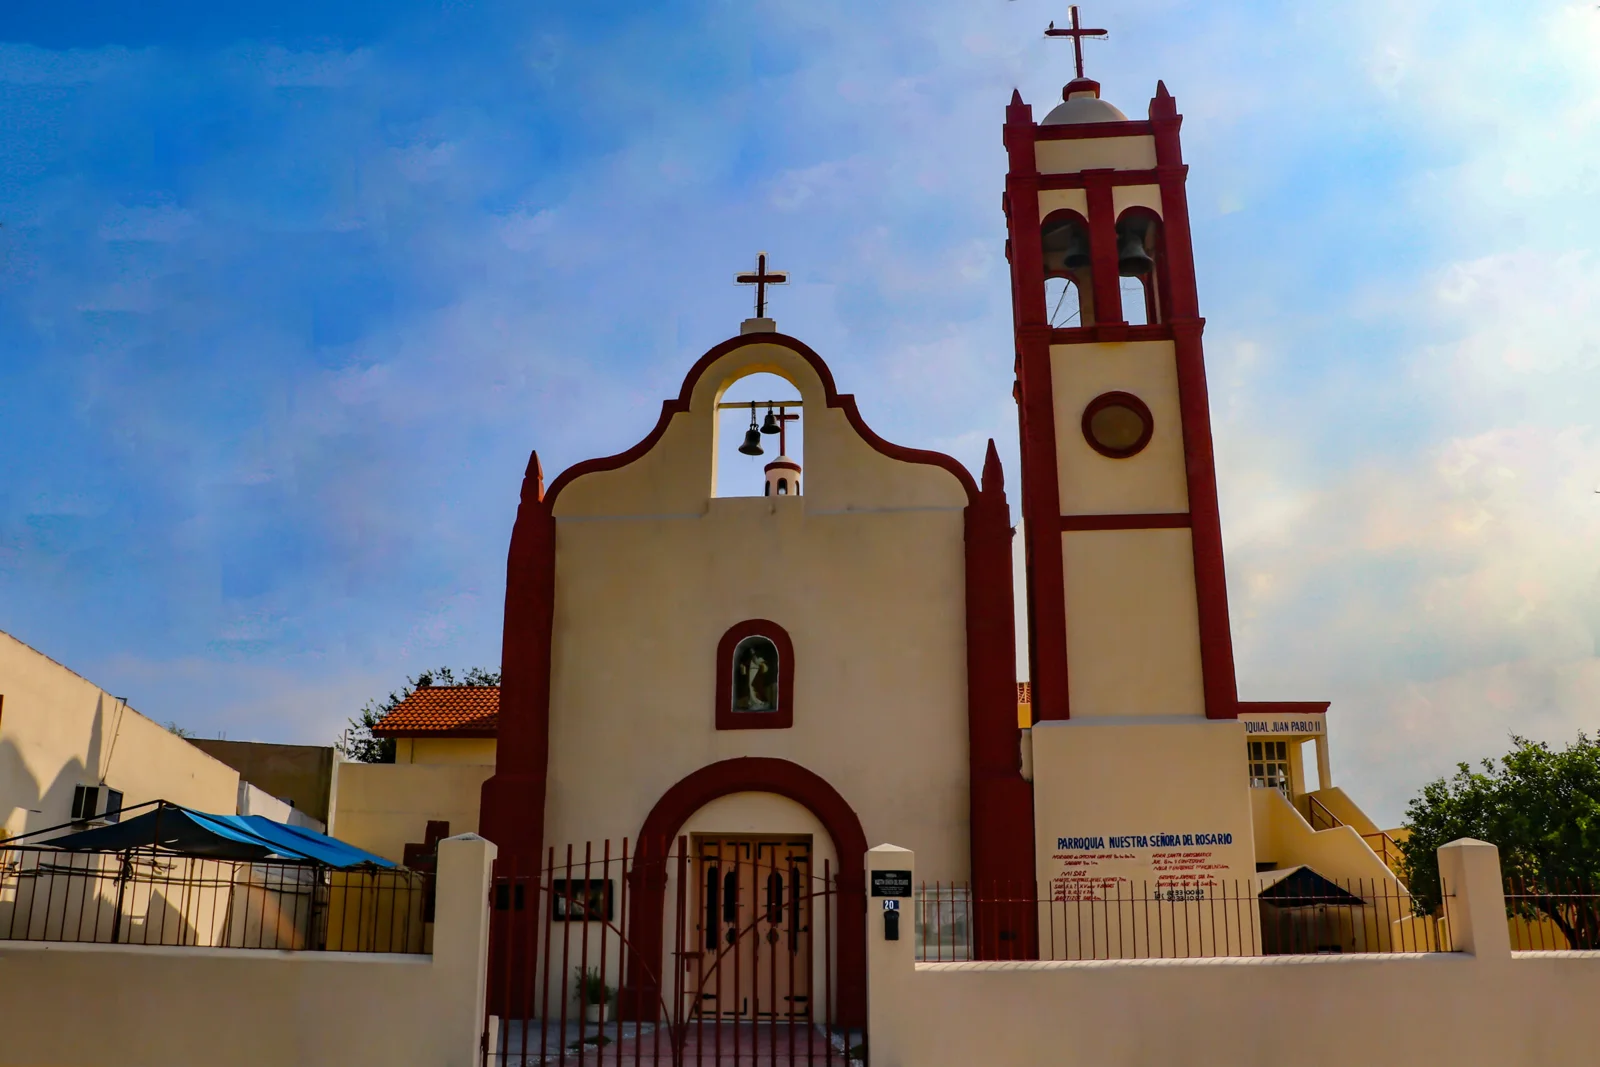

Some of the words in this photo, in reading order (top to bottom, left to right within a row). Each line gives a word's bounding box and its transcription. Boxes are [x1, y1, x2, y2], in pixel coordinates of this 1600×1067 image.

[1271, 721, 1289, 732] JUAN
[1290, 721, 1313, 732] PABLO
[1315, 721, 1321, 732] II
[1057, 837, 1105, 850] PARROQUIA
[1109, 835, 1148, 848] NUESTRA
[1149, 832, 1181, 847] SEÑORA
[1182, 834, 1194, 846] DEL
[1195, 833, 1232, 846] ROSARIO
[884, 900, 894, 910] 20
